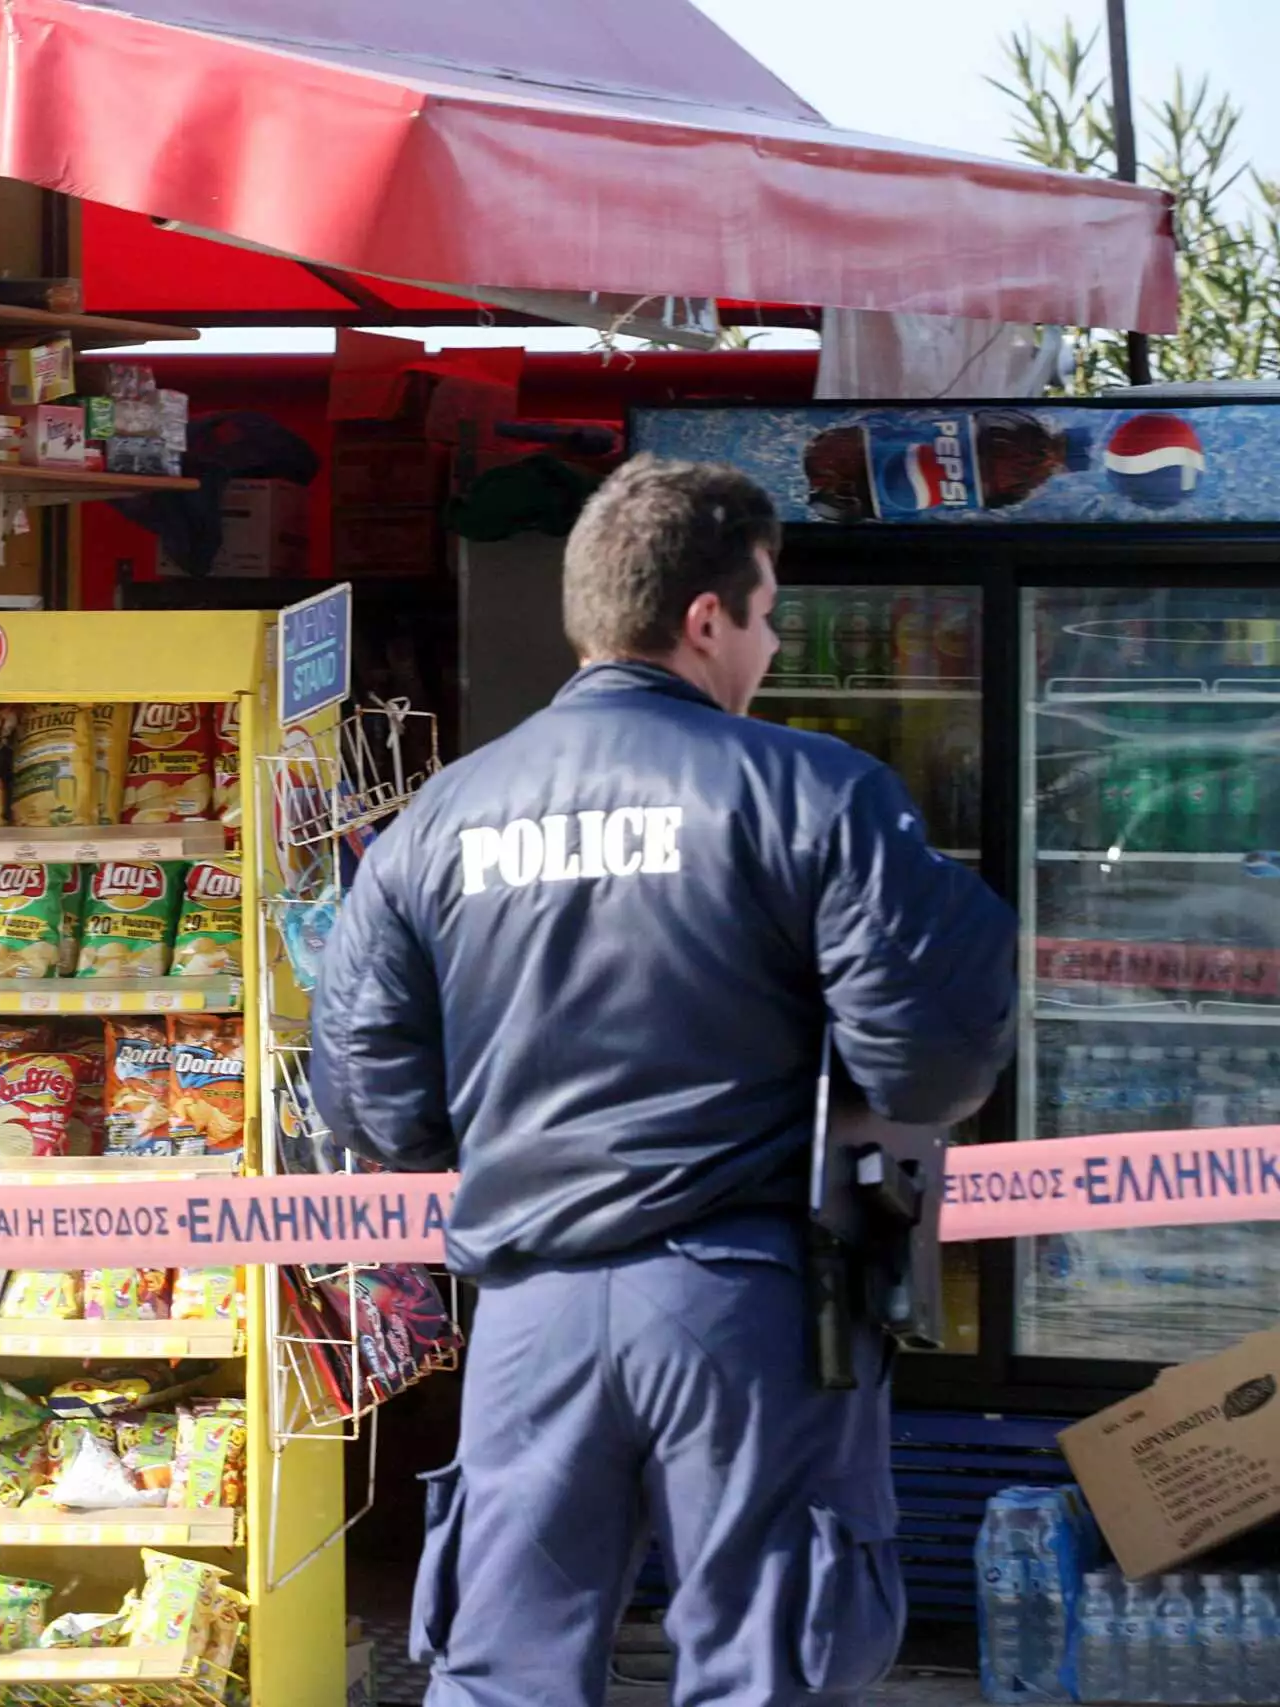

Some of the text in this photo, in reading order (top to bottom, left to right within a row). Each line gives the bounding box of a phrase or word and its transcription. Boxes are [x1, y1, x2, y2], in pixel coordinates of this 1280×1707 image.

[932, 421, 968, 506] PEPSI
[288, 598, 337, 653] NEWS
[293, 651, 337, 701] STAND
[459, 806, 682, 895] POLICE
[97, 863, 161, 897] Lay's
[193, 871, 242, 900] Lay
[120, 1045, 170, 1064] Dorit
[175, 1053, 244, 1075] Dorito
[943, 1168, 1067, 1204] ΕΙΣΟΔΟΣ
[27, 1208, 44, 1237] Η
[54, 1206, 170, 1237] ΕΙΣΟΔΟΣ
[187, 1193, 408, 1245] ΕΛΛΗΝΙΚΗ
